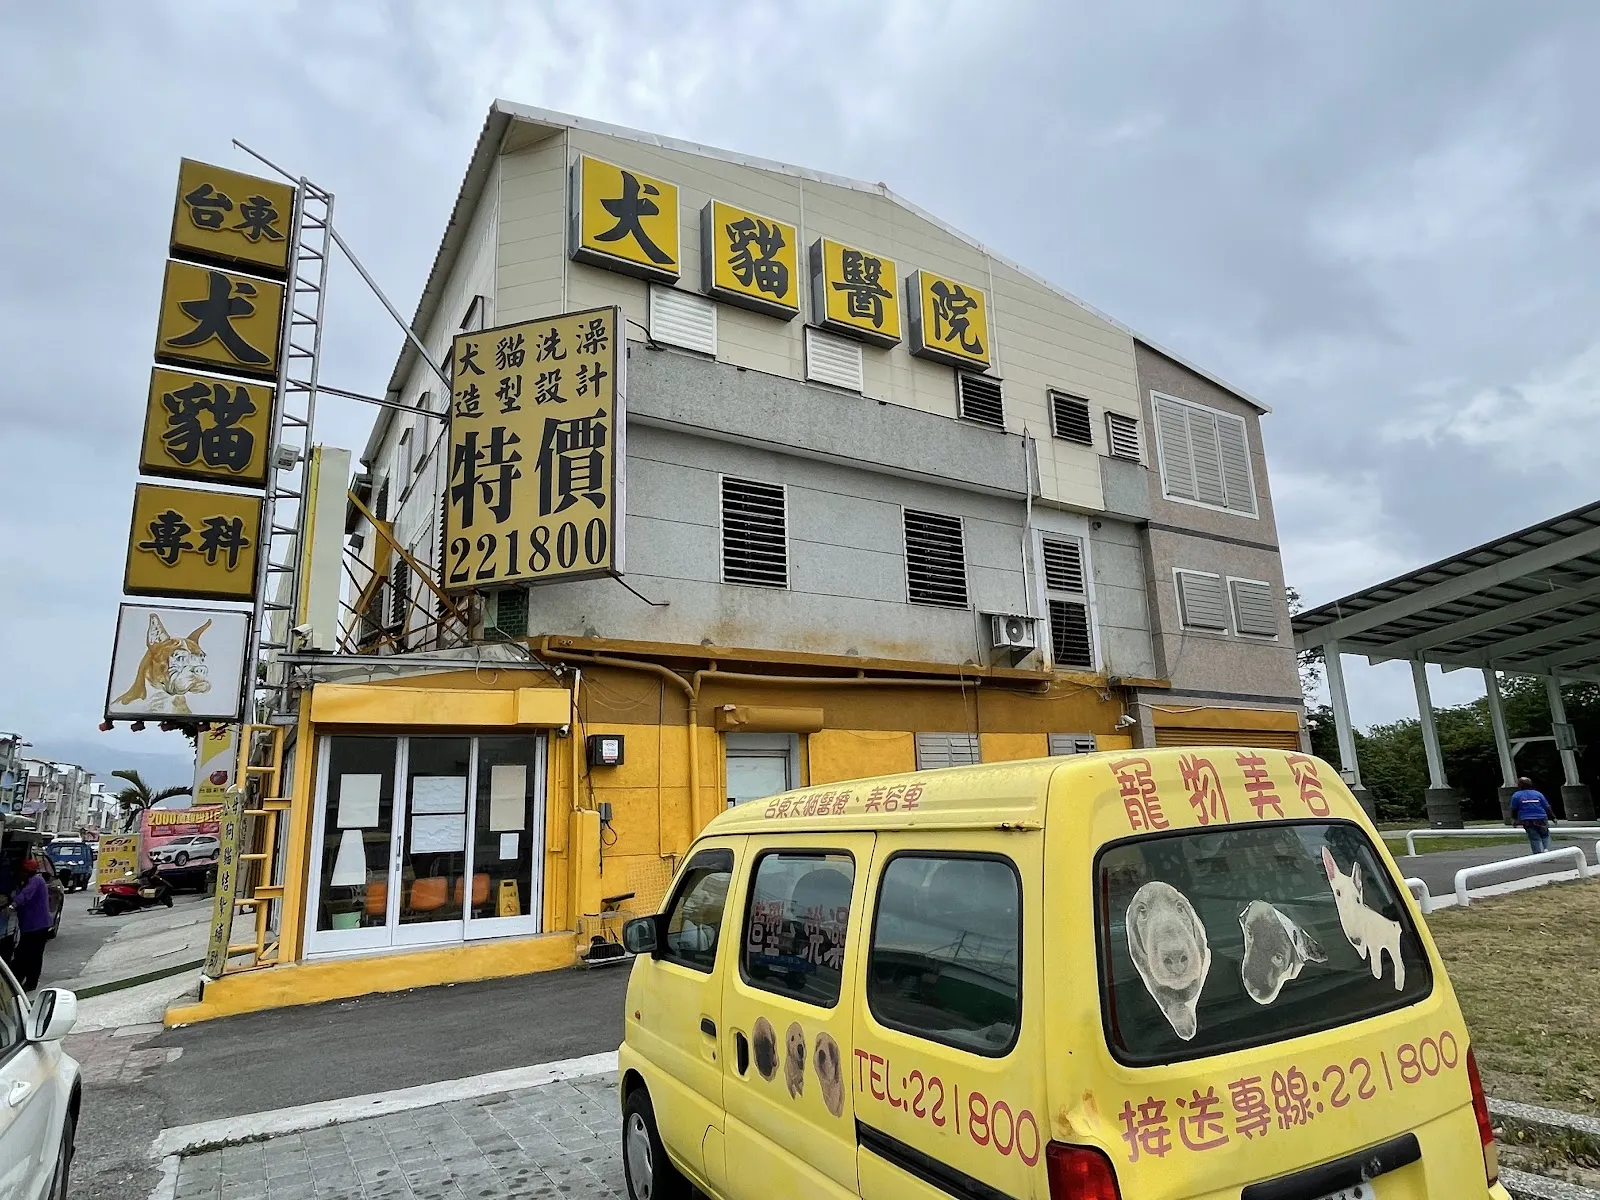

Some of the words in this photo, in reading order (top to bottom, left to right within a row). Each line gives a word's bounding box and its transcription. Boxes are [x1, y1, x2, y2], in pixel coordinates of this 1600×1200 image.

[185, 183, 284, 241] 台東
[594, 170, 983, 354] 犬貓醫院
[166, 271, 271, 363] 犬
[458, 318, 608, 377] 犬貓洗澡
[162, 381, 256, 471] 貓
[455, 361, 607, 419] 造型設計
[451, 407, 608, 529] 特價
[140, 510, 249, 570] 專科
[449, 517, 607, 583] 221800
[1108, 751, 1331, 831] 寵物美容
[854, 1048, 1041, 1167] TEL:221800
[1118, 1030, 1459, 1163] 接送專線:221800
